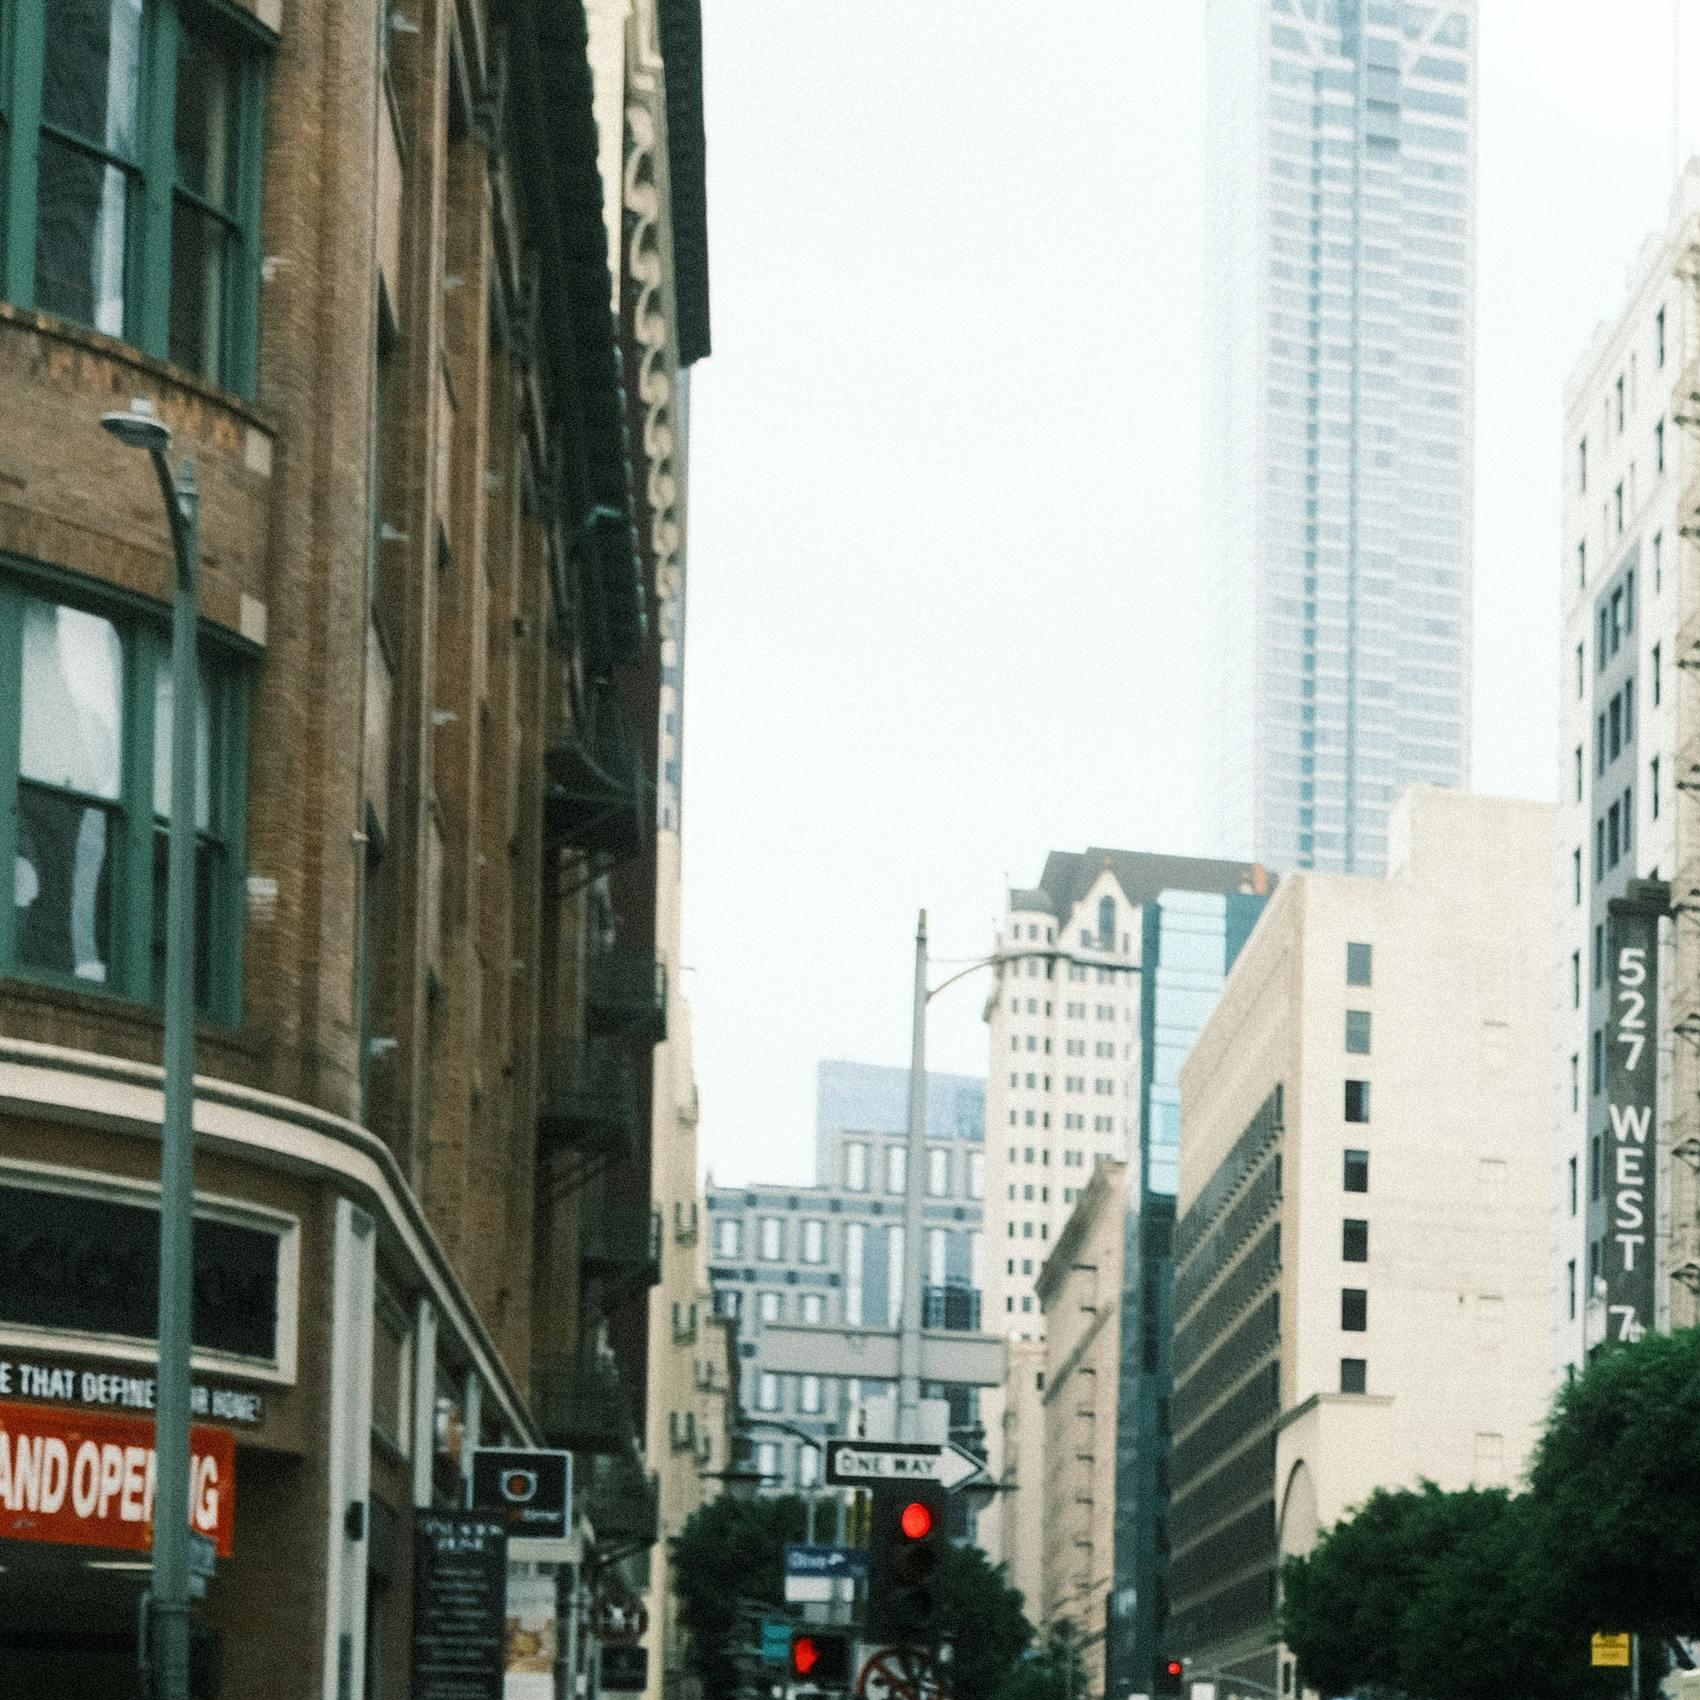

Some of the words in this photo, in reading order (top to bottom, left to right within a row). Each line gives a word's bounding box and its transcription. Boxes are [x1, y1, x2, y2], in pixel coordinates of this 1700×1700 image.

[1617, 947, 1647, 1071] 527
[1609, 1104, 1651, 1271] WEST
[19, 1363, 76, 1400] THAT
[842, 1454, 880, 1471] ONE
[894, 1457, 935, 1472] WAY
